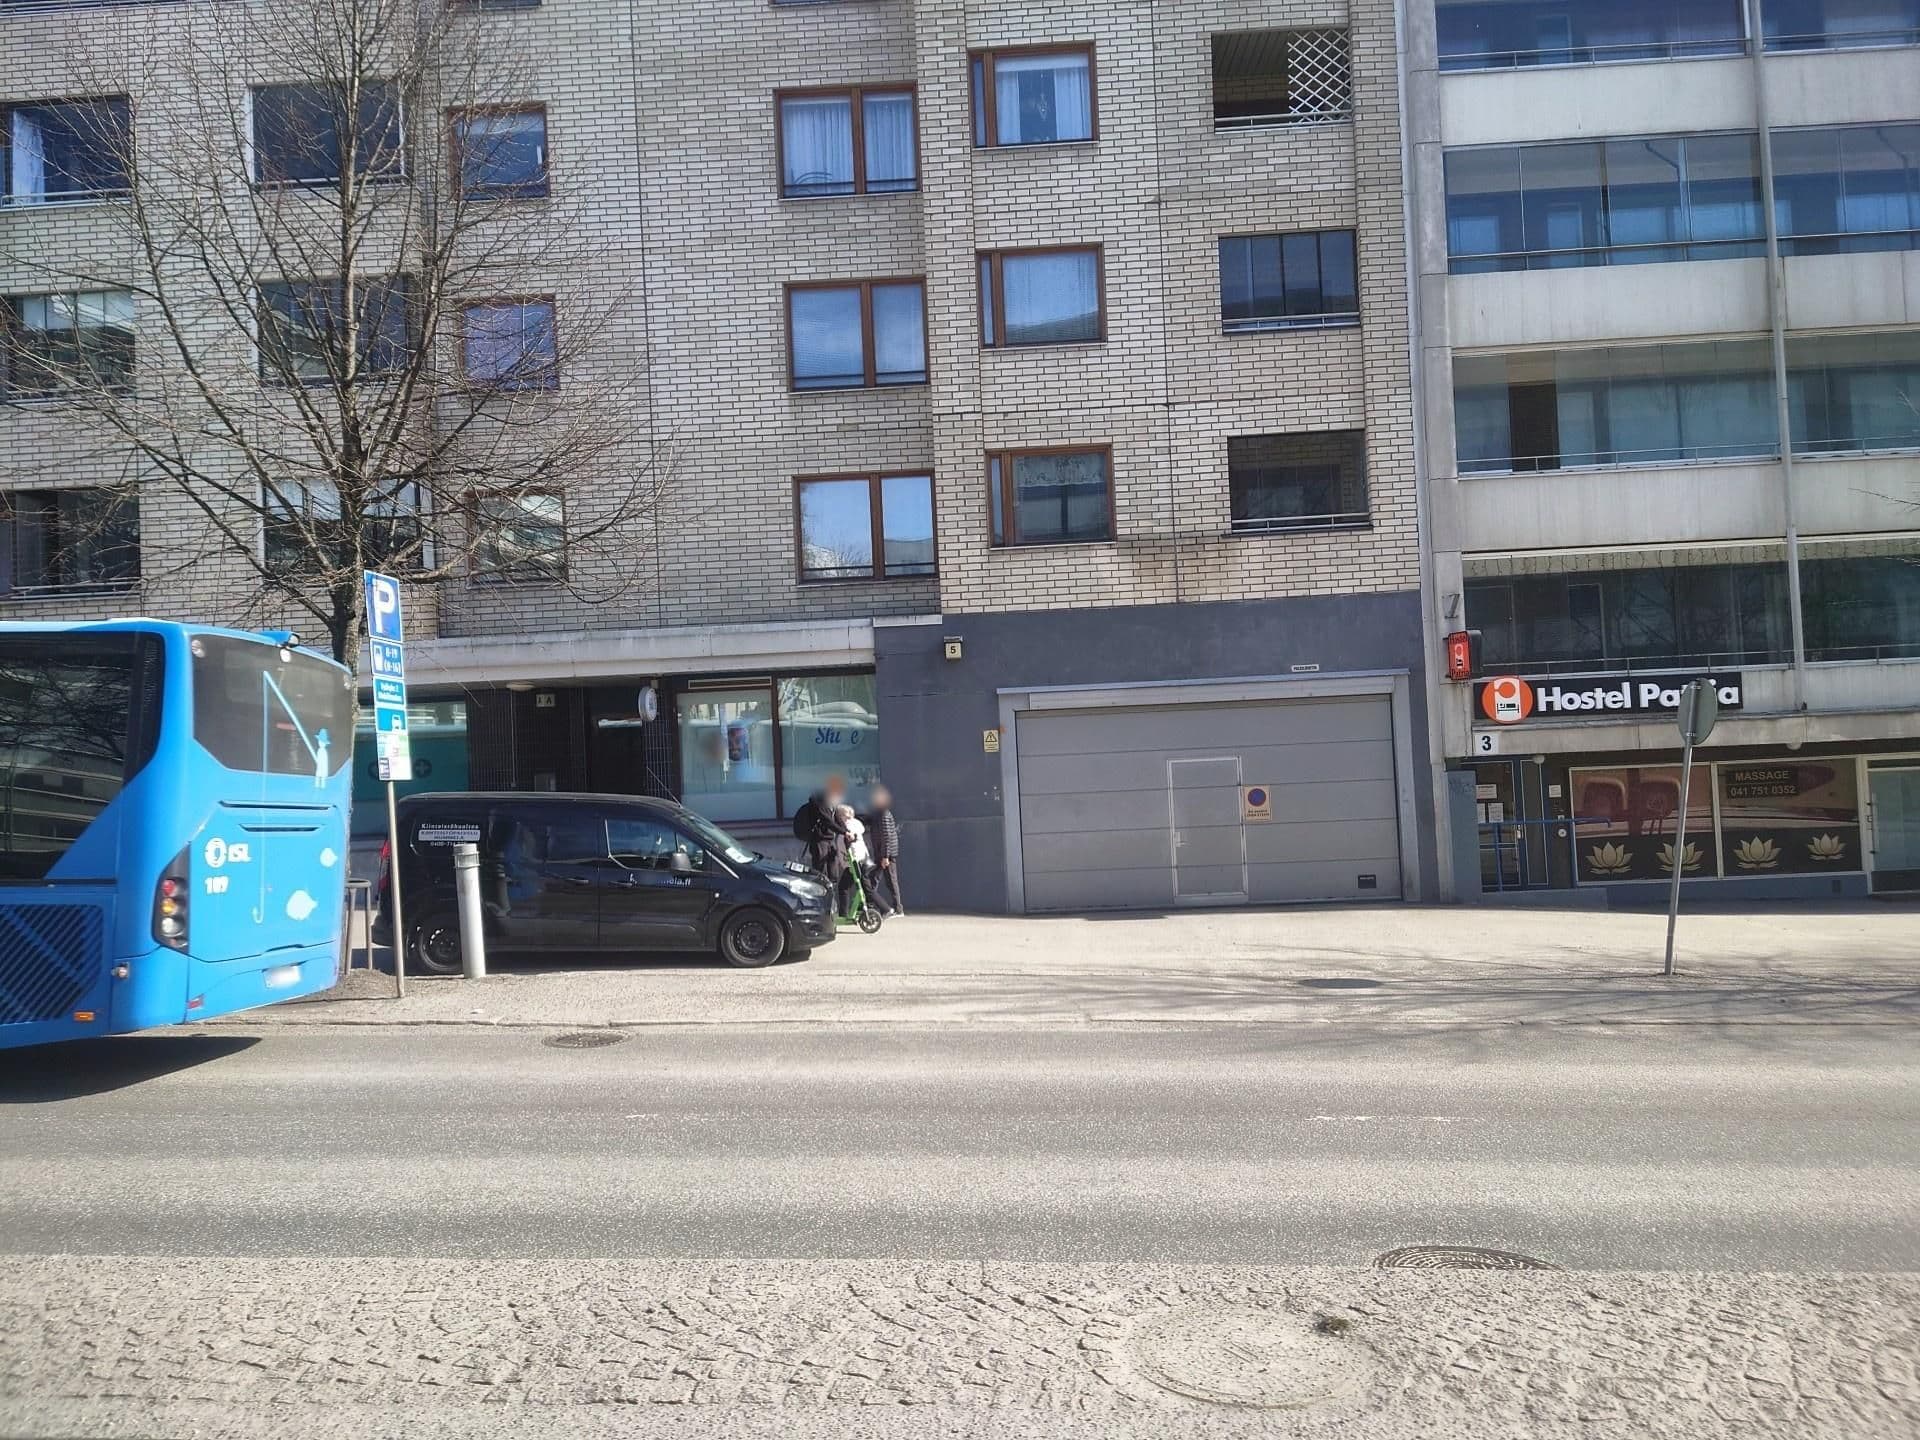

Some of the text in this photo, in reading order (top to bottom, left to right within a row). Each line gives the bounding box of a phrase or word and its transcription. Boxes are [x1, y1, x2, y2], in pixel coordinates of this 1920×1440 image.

[372, 578, 395, 634] P
[950, 645, 956, 654] 5
[1536, 682, 1632, 712] Hostel
[1481, 735, 1492, 751] 3
[1735, 770, 1790, 782] MASSAGE
[1730, 785, 1797, 797] 041 751 0352
